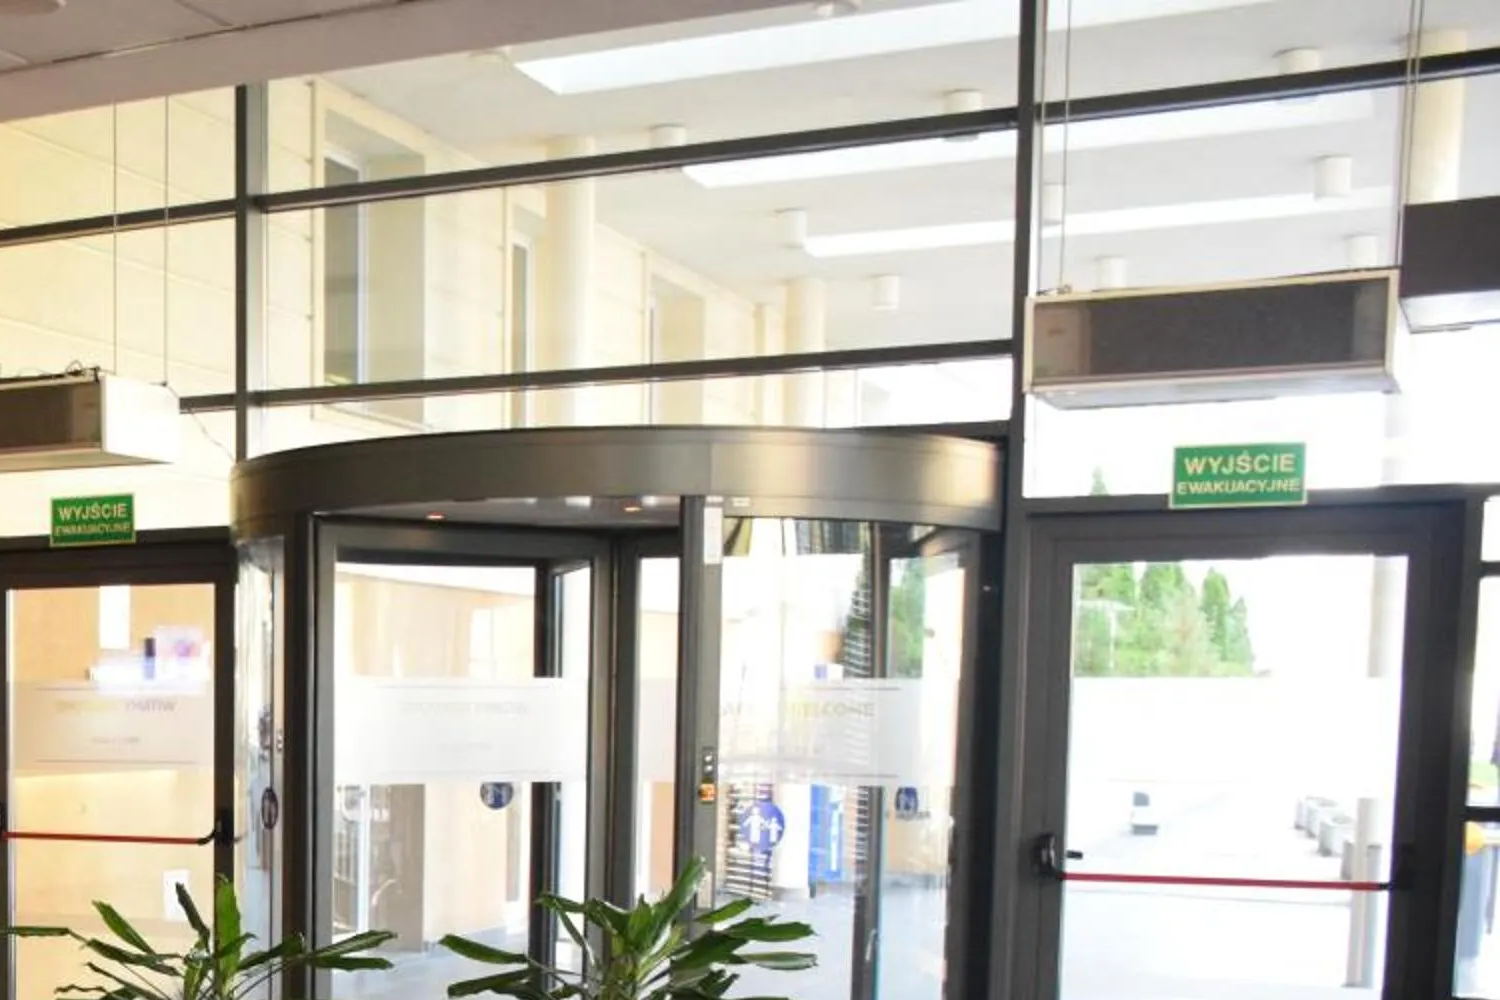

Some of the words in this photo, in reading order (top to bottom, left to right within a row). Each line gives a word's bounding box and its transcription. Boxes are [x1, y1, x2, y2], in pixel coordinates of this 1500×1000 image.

[1184, 450, 1296, 475] WYJŚCIE
[1177, 479, 1301, 495] EWAKUACYJNE
[59, 502, 128, 520] WYJŚCIE
